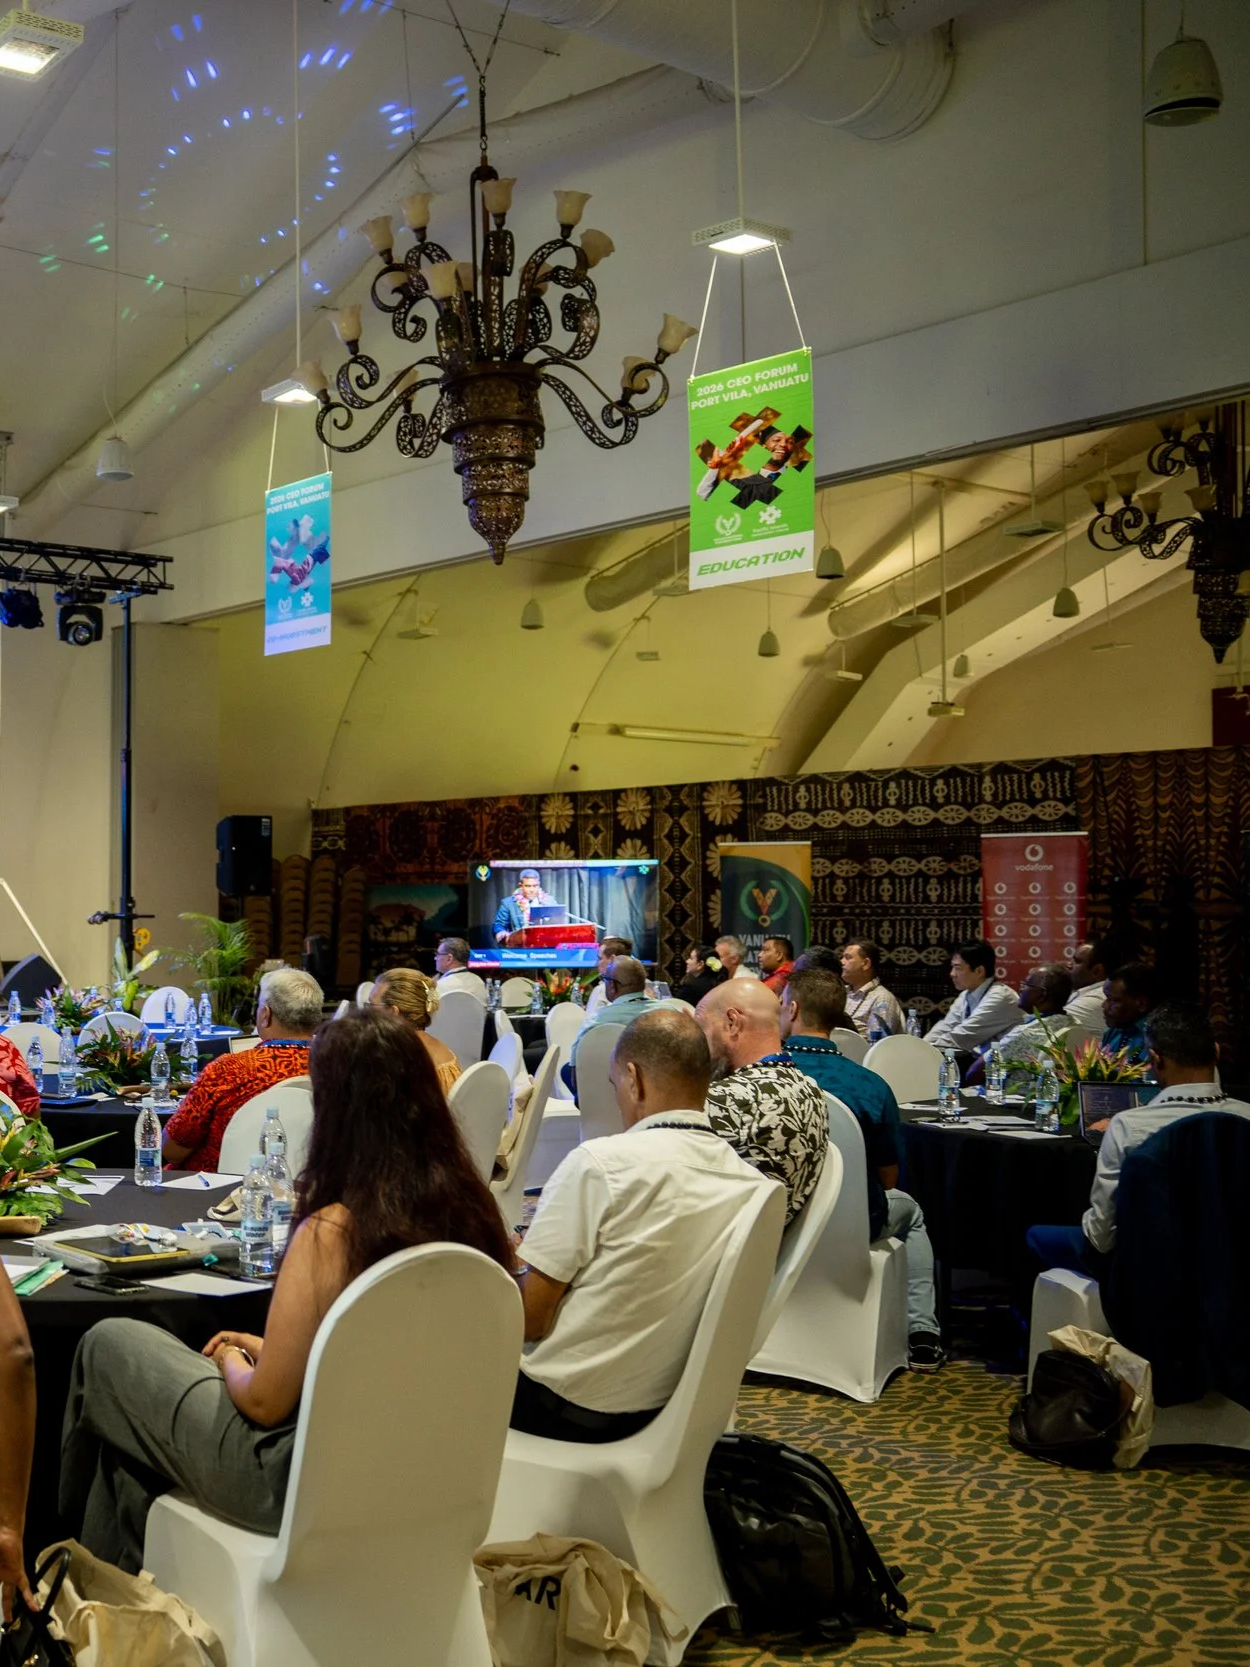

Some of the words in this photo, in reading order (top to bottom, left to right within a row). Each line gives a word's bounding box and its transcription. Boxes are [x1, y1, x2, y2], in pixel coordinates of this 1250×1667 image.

[691, 395, 720, 410] PORT
[722, 388, 752, 403] VILA,
[753, 373, 809, 394] VANUATU
[696, 382, 725, 397] 2026
[726, 375, 752, 389] CEO
[754, 363, 799, 382] FORUM
[696, 547, 806, 577] EDUCATION
[1014, 863, 1054, 872] vodafone
